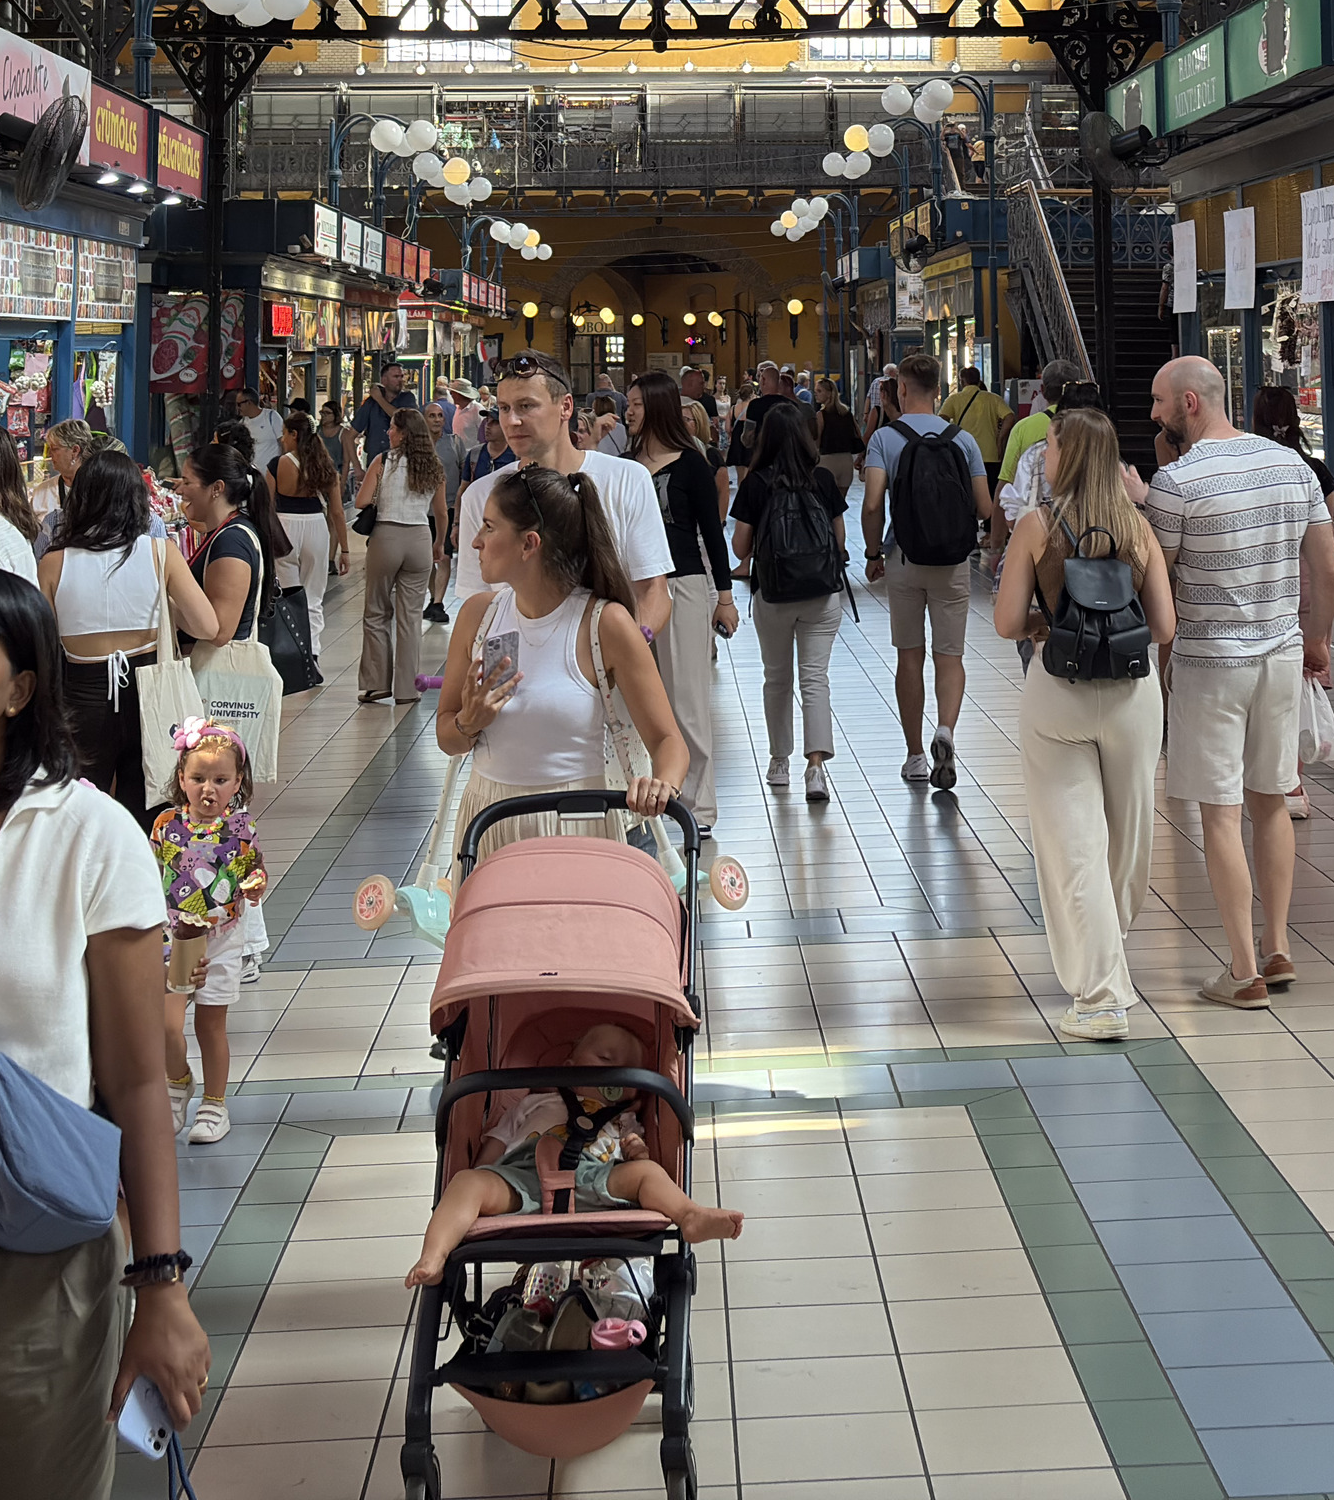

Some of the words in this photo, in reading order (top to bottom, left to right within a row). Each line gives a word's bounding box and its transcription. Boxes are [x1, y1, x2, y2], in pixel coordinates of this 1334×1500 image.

[2, 51, 49, 102] Chocolate
[95, 99, 137, 155] GYÜMÖLCS
[407, 308, 426, 318] ALÁMI
[210, 700, 255, 710] CORVINUS
[210, 708, 261, 719] UNIVERSITY
